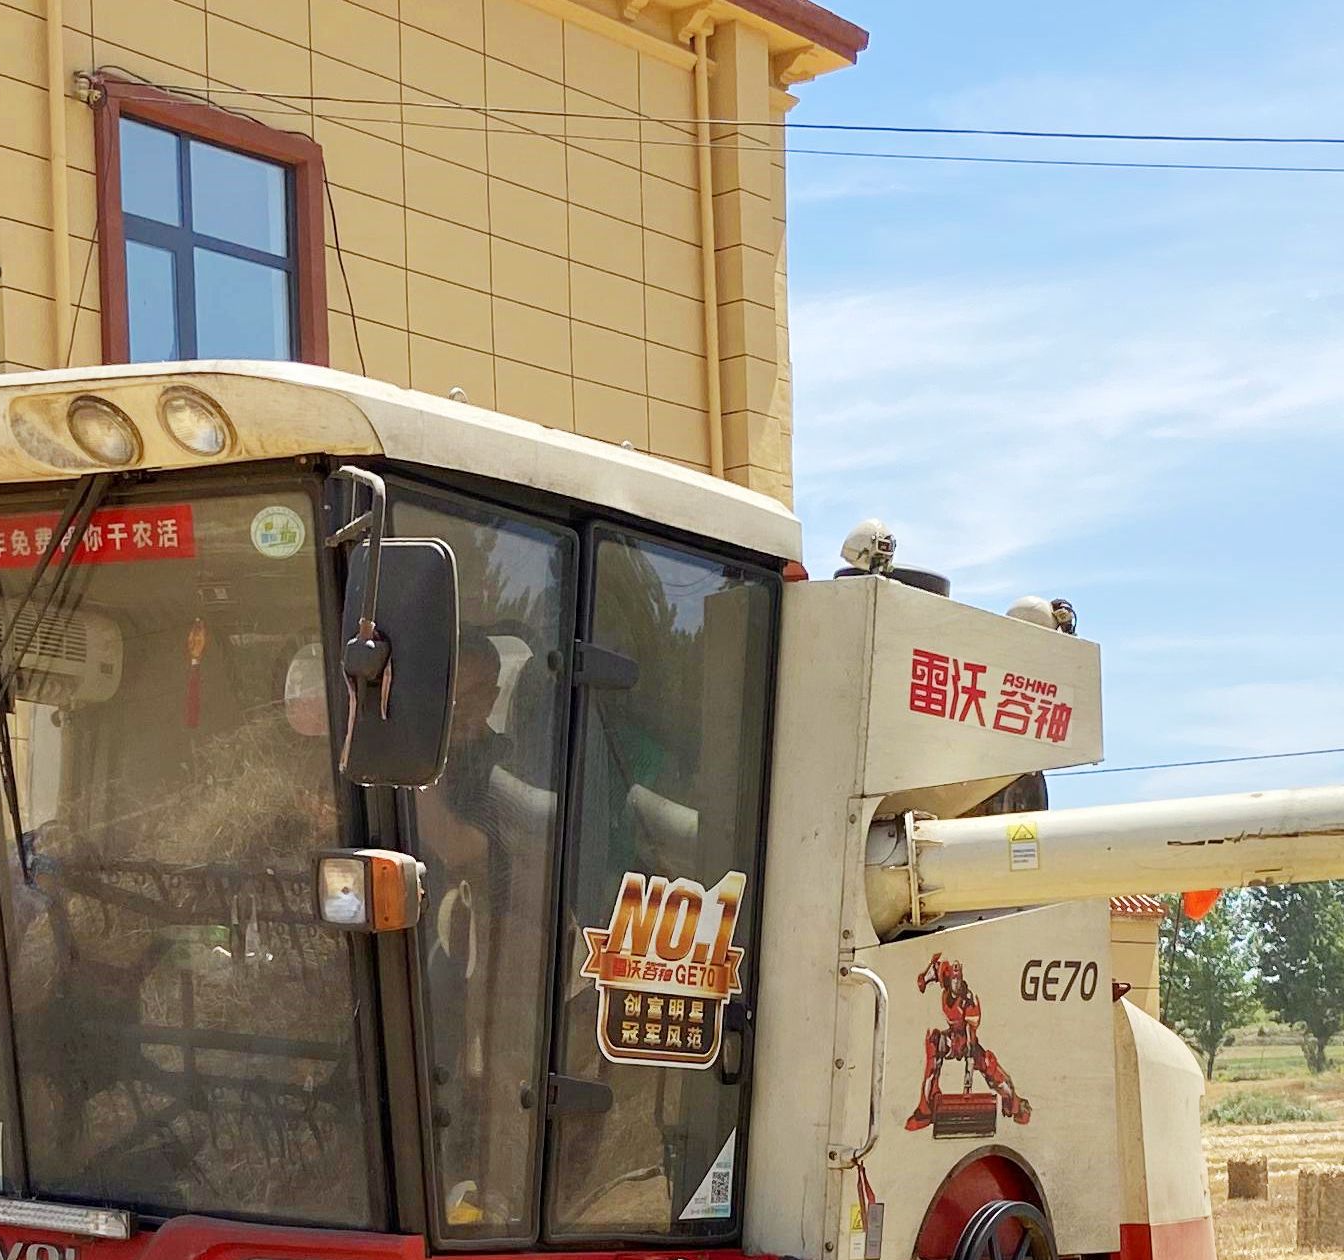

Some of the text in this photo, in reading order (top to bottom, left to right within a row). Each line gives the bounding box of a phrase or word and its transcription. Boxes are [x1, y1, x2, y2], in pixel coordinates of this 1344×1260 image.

[1002, 672, 1058, 698] ASHNA
[606, 874, 746, 966] NO.1
[675, 963, 715, 988] GE70
[1020, 959, 1099, 1002] GE70
[622, 992, 705, 1025] 创富明星
[620, 1021, 705, 1050] 冠军风范
